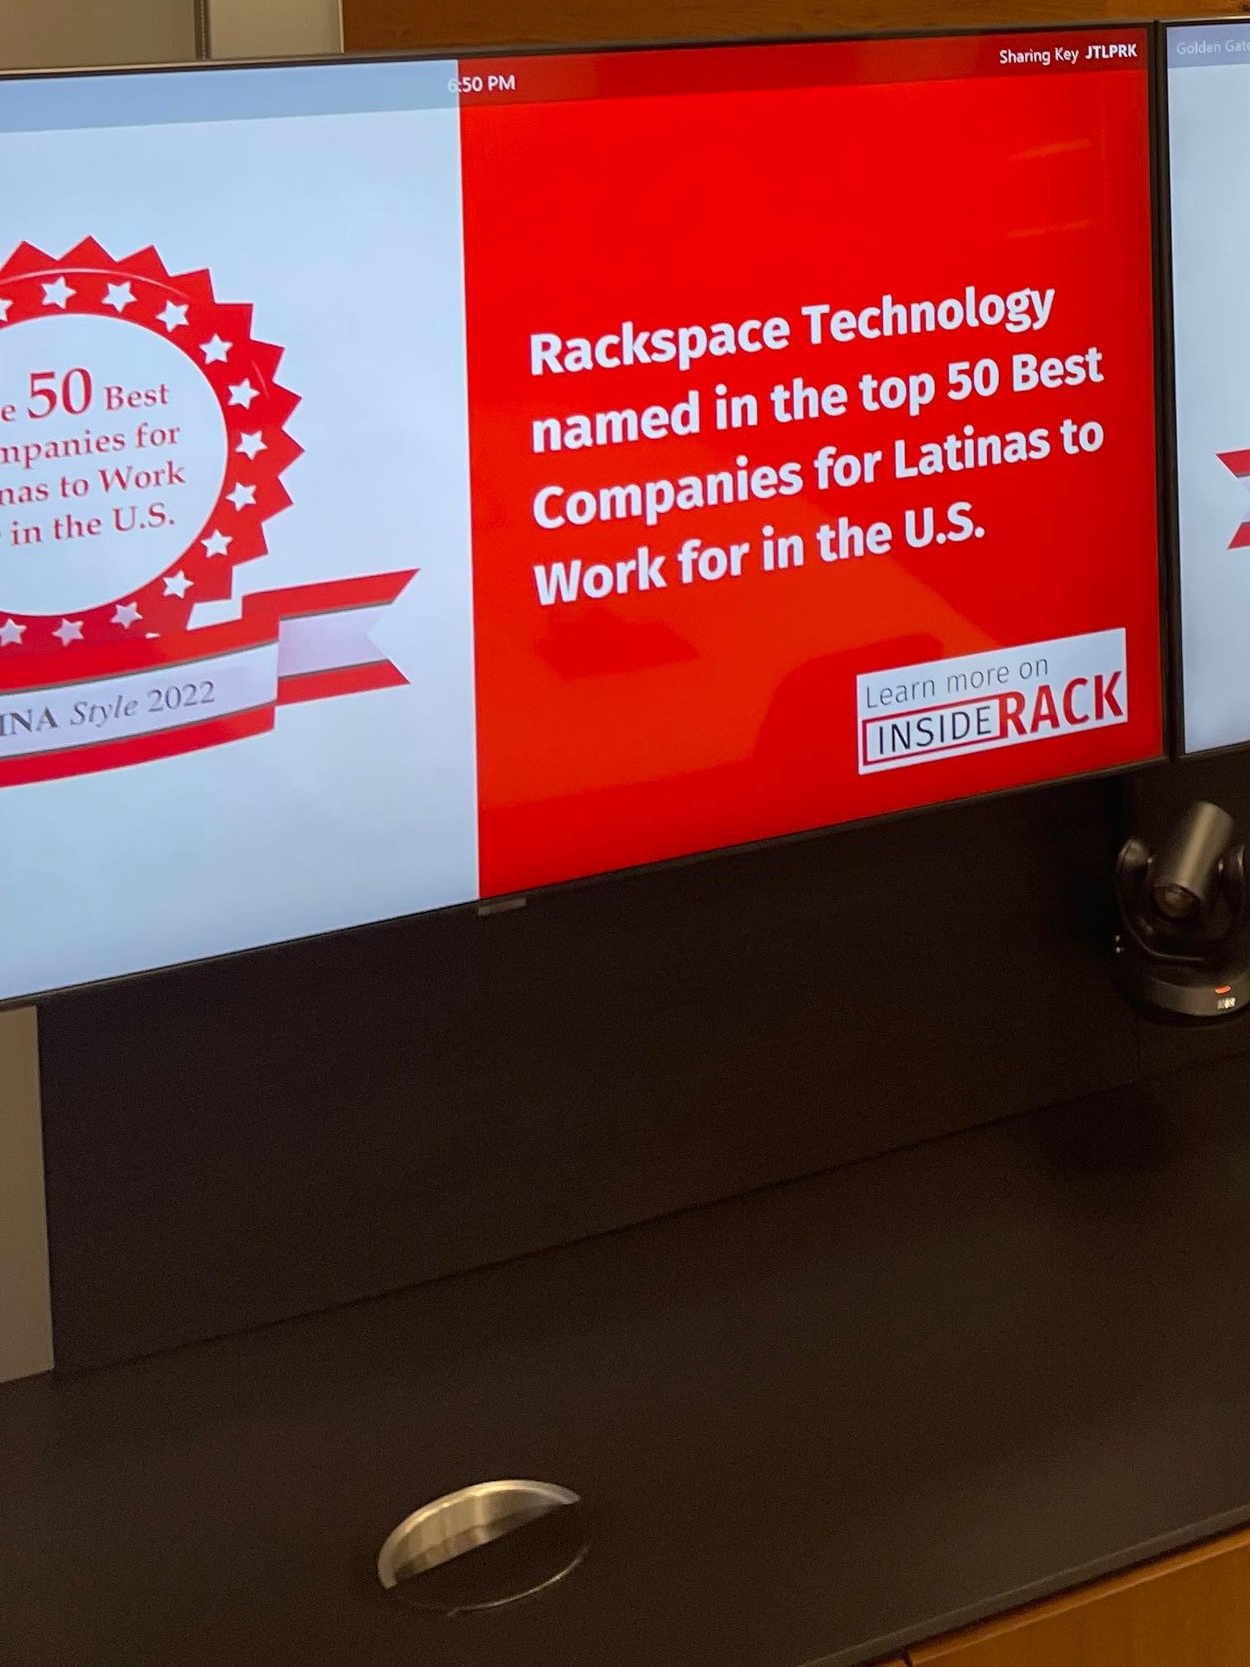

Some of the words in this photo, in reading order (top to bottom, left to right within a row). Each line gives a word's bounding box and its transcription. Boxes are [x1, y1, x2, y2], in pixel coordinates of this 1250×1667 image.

[999, 48, 1051, 66] Sharing
[1054, 47, 1079, 65] Key
[1085, 43, 1138, 60] JTLPRK
[1176, 40, 1221, 55] Golden
[447, 76, 483, 93] 6:50
[487, 74, 516, 92] PM
[529, 320, 791, 376] Rackspace
[801, 285, 1056, 345] Technology
[27, 367, 93, 420] 50
[103, 383, 170, 412] Best
[532, 389, 700, 454] named
[714, 383, 758, 430] in
[770, 376, 849, 424] the
[858, 373, 936, 417] top
[947, 357, 1000, 401] 50
[1011, 346, 1105, 393] Best
[134, 421, 182, 449] for
[60, 476, 90, 499] to
[98, 460, 187, 494] Work
[532, 454, 804, 530] Companies
[813, 445, 883, 491] for
[894, 425, 1051, 479] Latinas
[1059, 418, 1105, 456] to
[10, 520, 43, 547] in
[52, 513, 103, 542] the
[112, 502, 176, 533] U.S.
[533, 546, 668, 607] Work
[677, 538, 750, 584] for
[762, 525, 804, 571] in
[815, 516, 894, 564] the
[904, 501, 986, 549] U.S.
[69, 694, 140, 728] Style
[147, 680, 216, 713] 2022
[865, 678, 937, 710] Learn
[946, 665, 1011, 694] more
[1018, 657, 1050, 681] on
